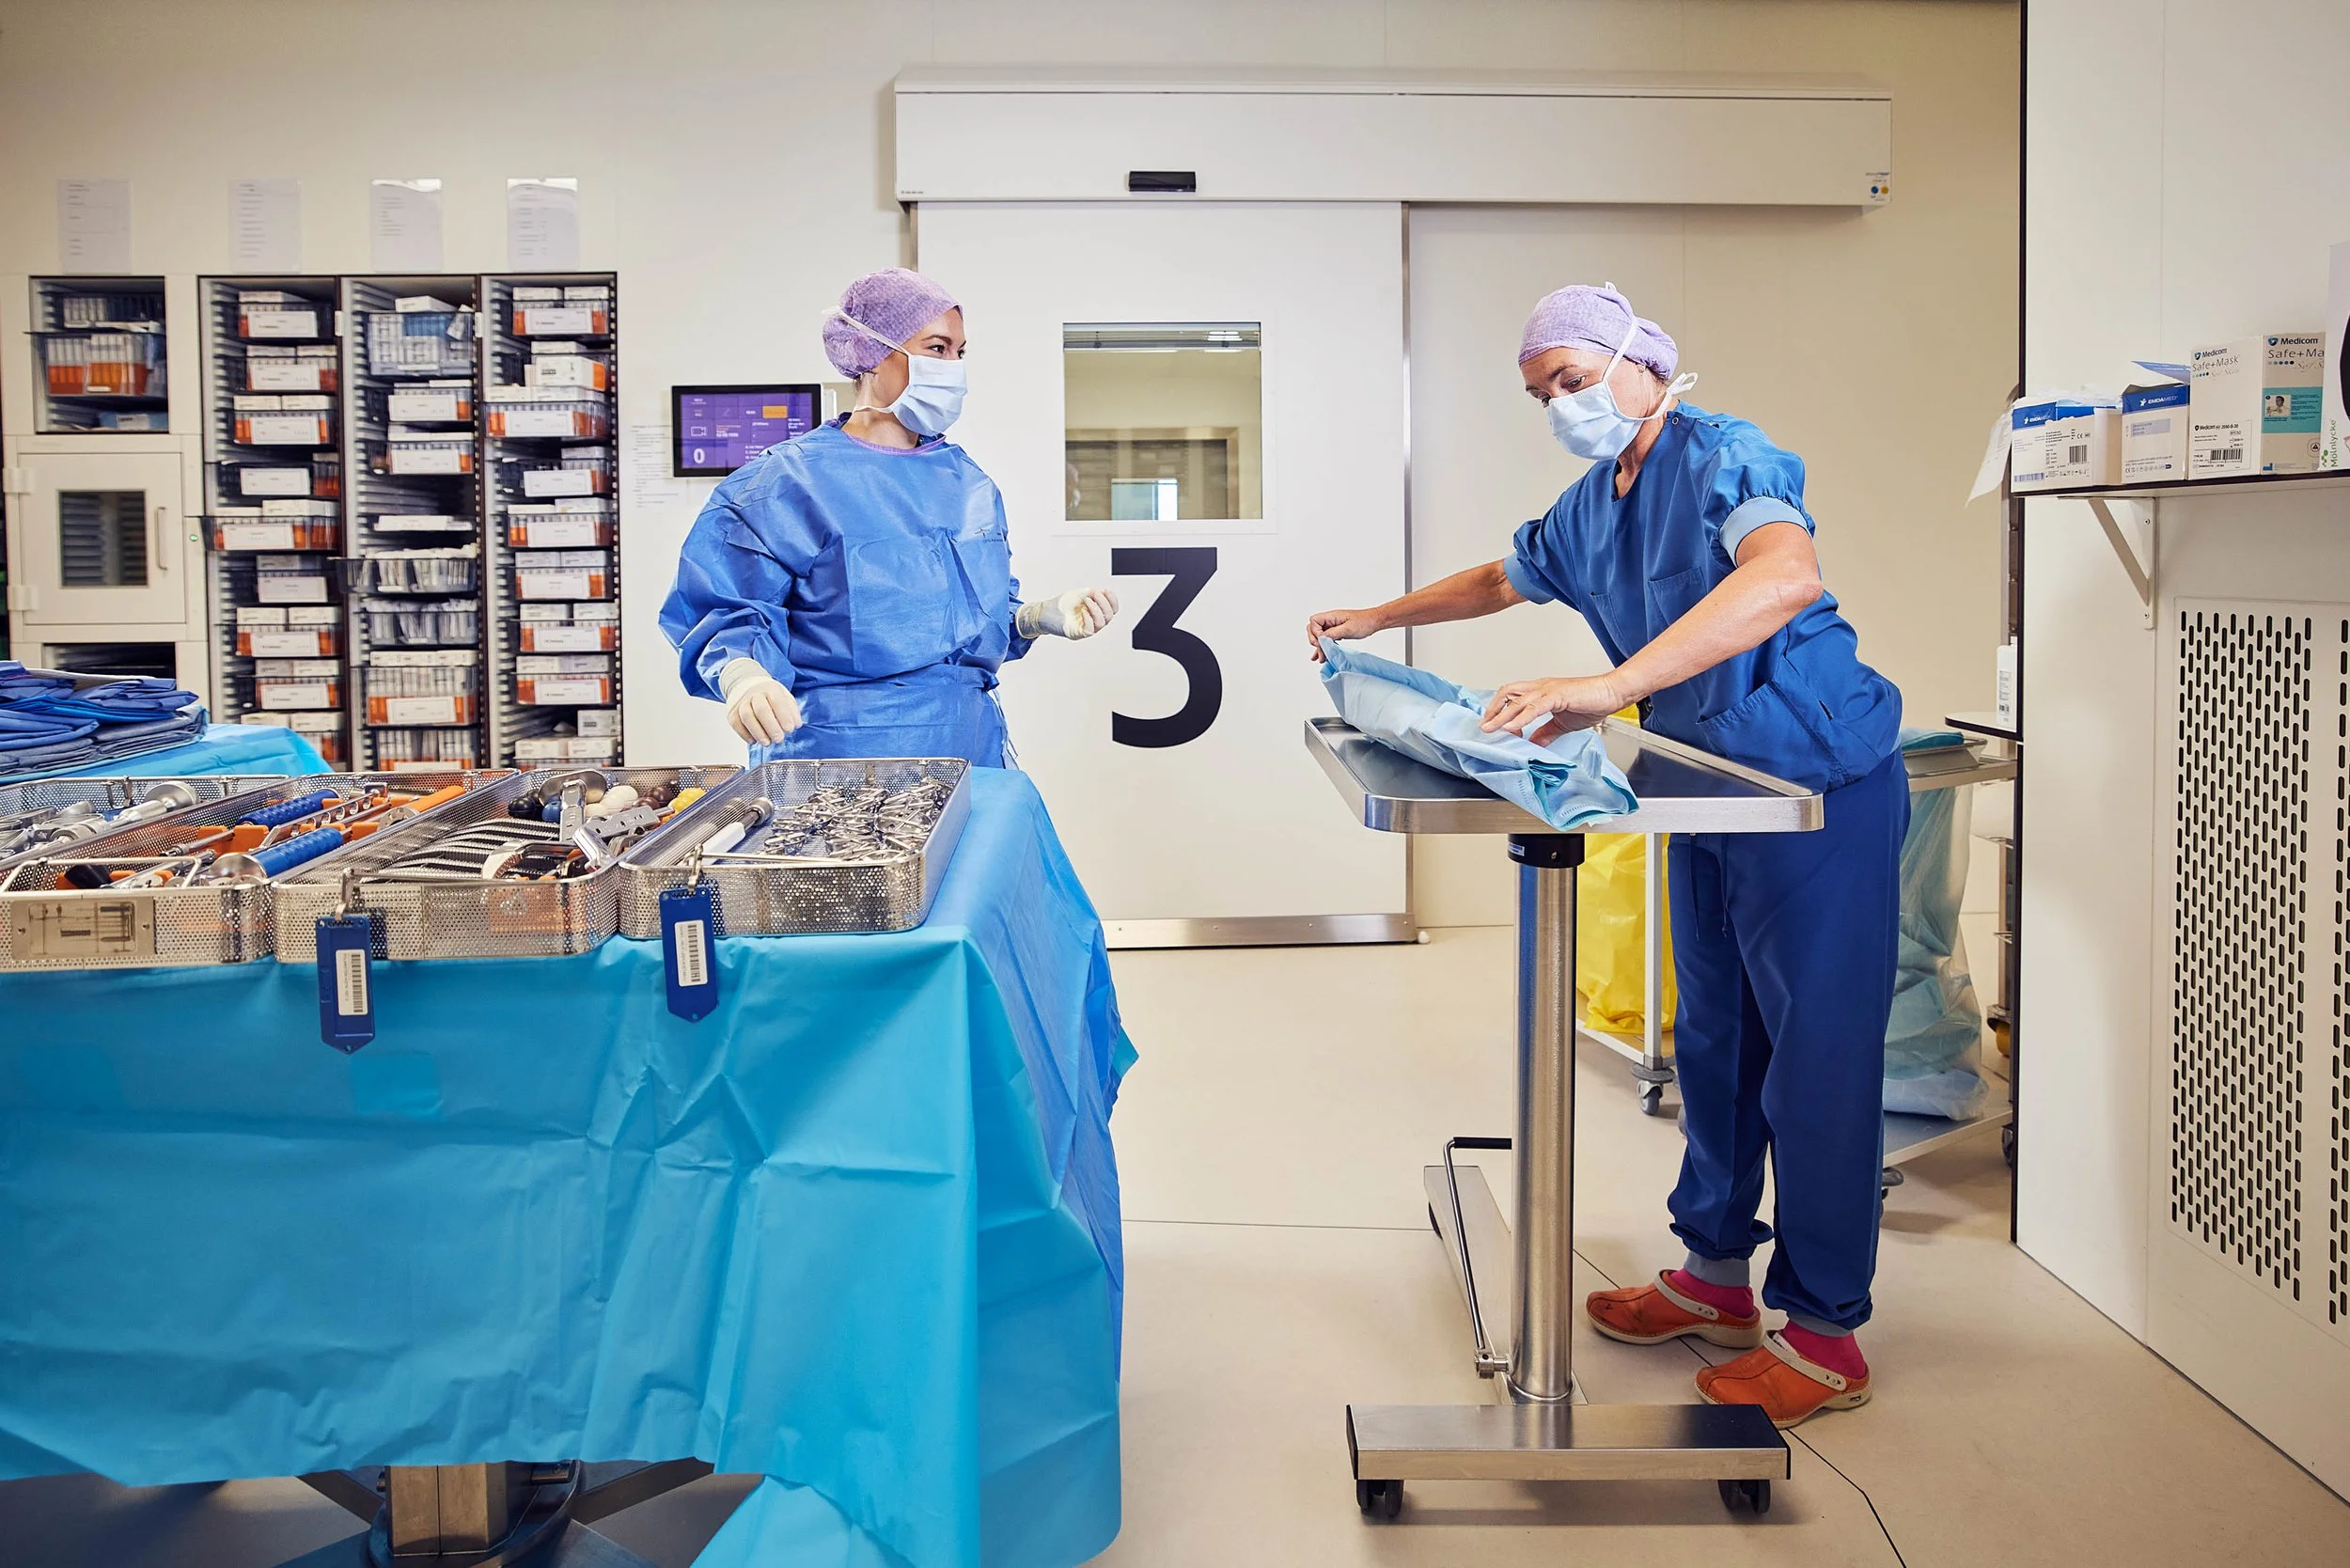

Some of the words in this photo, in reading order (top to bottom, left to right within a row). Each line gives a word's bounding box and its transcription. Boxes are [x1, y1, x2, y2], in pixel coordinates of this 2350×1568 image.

[2201, 348, 2228, 358] Medicom
[2268, 348, 2325, 359] Safe+Ma
[2192, 354, 2240, 372] Safe+Mask
[1111, 547, 1223, 748] 3
